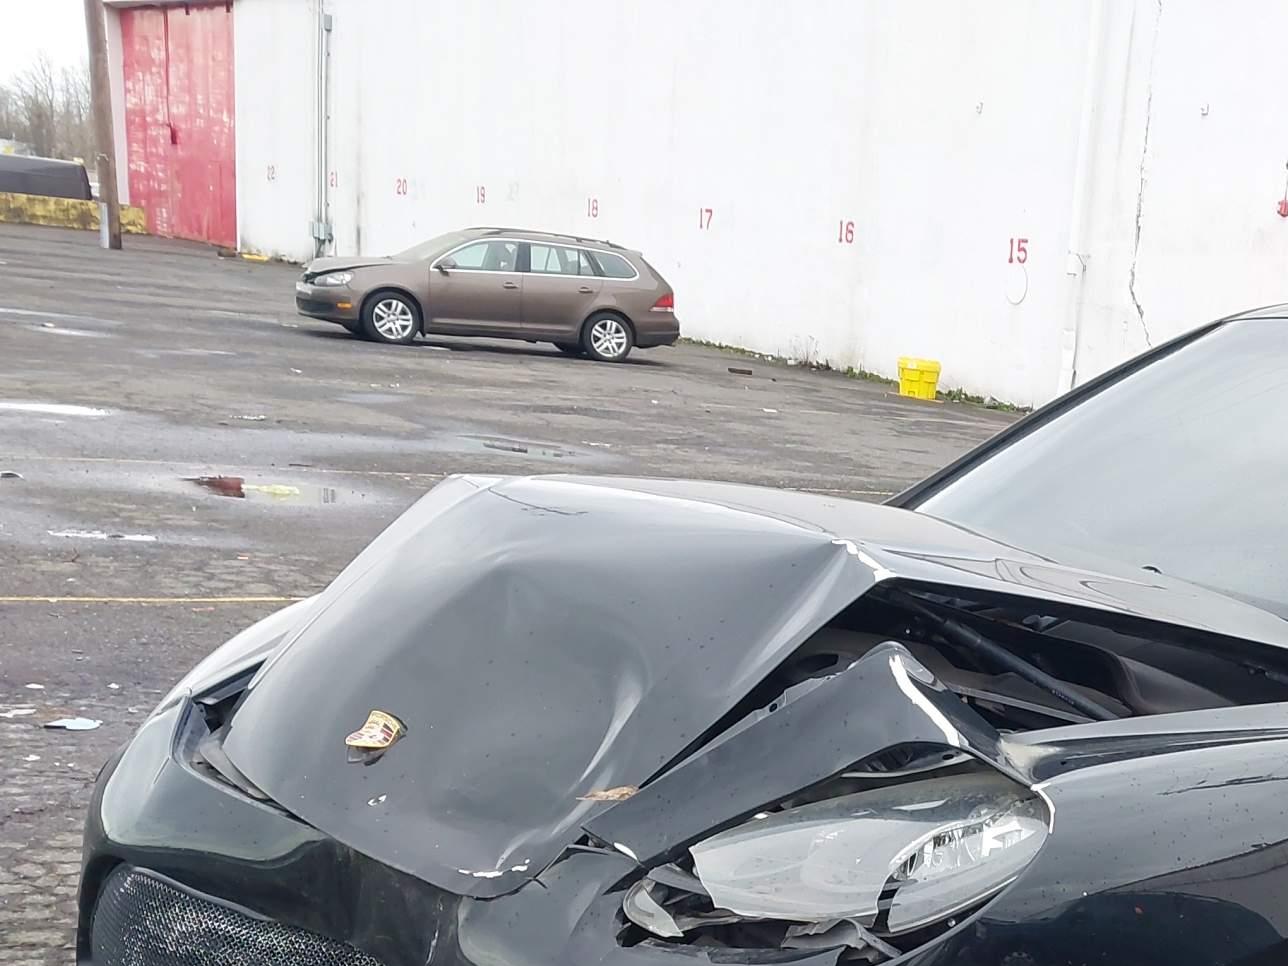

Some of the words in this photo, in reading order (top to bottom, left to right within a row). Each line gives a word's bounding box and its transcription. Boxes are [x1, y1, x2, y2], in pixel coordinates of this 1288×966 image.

[329, 171, 338, 188] 21
[396, 178, 408, 196] 20
[476, 186, 486, 204] 19
[587, 198, 599, 218] 18
[699, 208, 713, 231] 17
[838, 220, 855, 244] 16
[1008, 238, 1029, 264] 15
